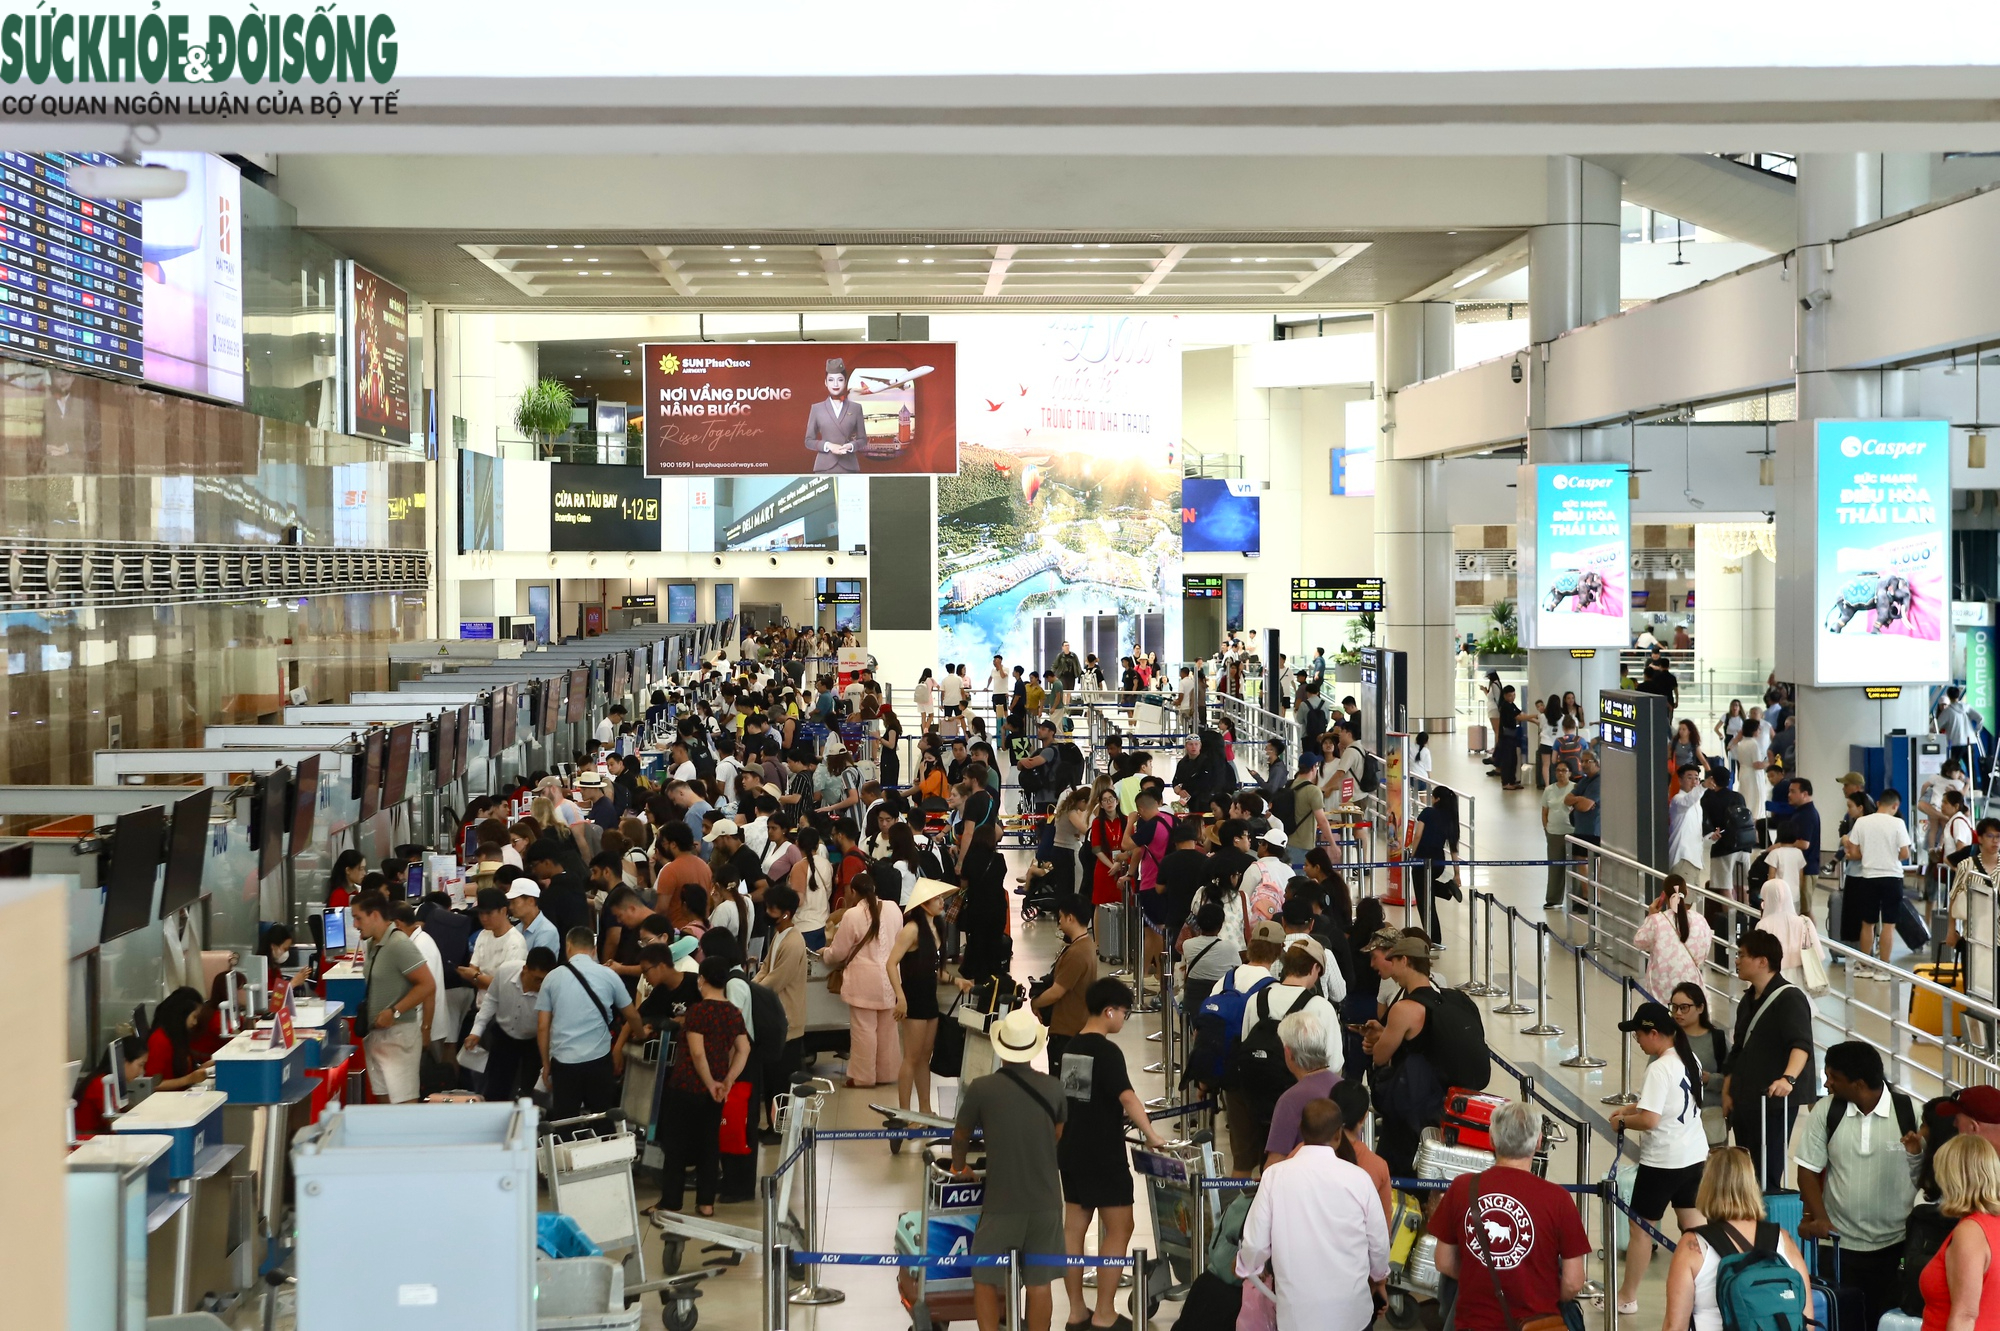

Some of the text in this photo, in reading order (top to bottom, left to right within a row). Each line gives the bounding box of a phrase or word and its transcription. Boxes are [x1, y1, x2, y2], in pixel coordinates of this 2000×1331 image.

[682, 358, 751, 368] SUN PhuQuoc
[660, 383, 792, 401] NƠI VẦNG DƯƠNG
[660, 401, 752, 416] NÂNG BƯỚC
[659, 419, 764, 452] Rise Together
[1862, 439, 1927, 459] Casper
[695, 461, 769, 469] sunphuquocairways.com
[815, 483, 830, 496] FOOD
[1568, 476, 1614, 491] Casper
[555, 489, 618, 508] CỬA RA TÀU BAY
[1888, 484, 1931, 504] HÒA
[621, 498, 644, 520] 1-12
[754, 503, 775, 526] MART
[1836, 503, 1937, 524] THÁI LAN
[555, 512, 576, 524] Boarding
[1550, 520, 1620, 536] THÁI LAN
[1308, 579, 1316, 588] B
[1975, 631, 1987, 708] BAMBOO
[946, 1188, 982, 1204] ACV
[1469, 1196, 1530, 1228] INGERS
[820, 1254, 841, 1263] ACV
[1469, 1237, 1527, 1267] WETERN
[878, 1256, 899, 1265] ACV
[936, 1256, 957, 1266] ACV
[1066, 1256, 1085, 1265] N.I.A
[1103, 1256, 1126, 1266] CẢNG
